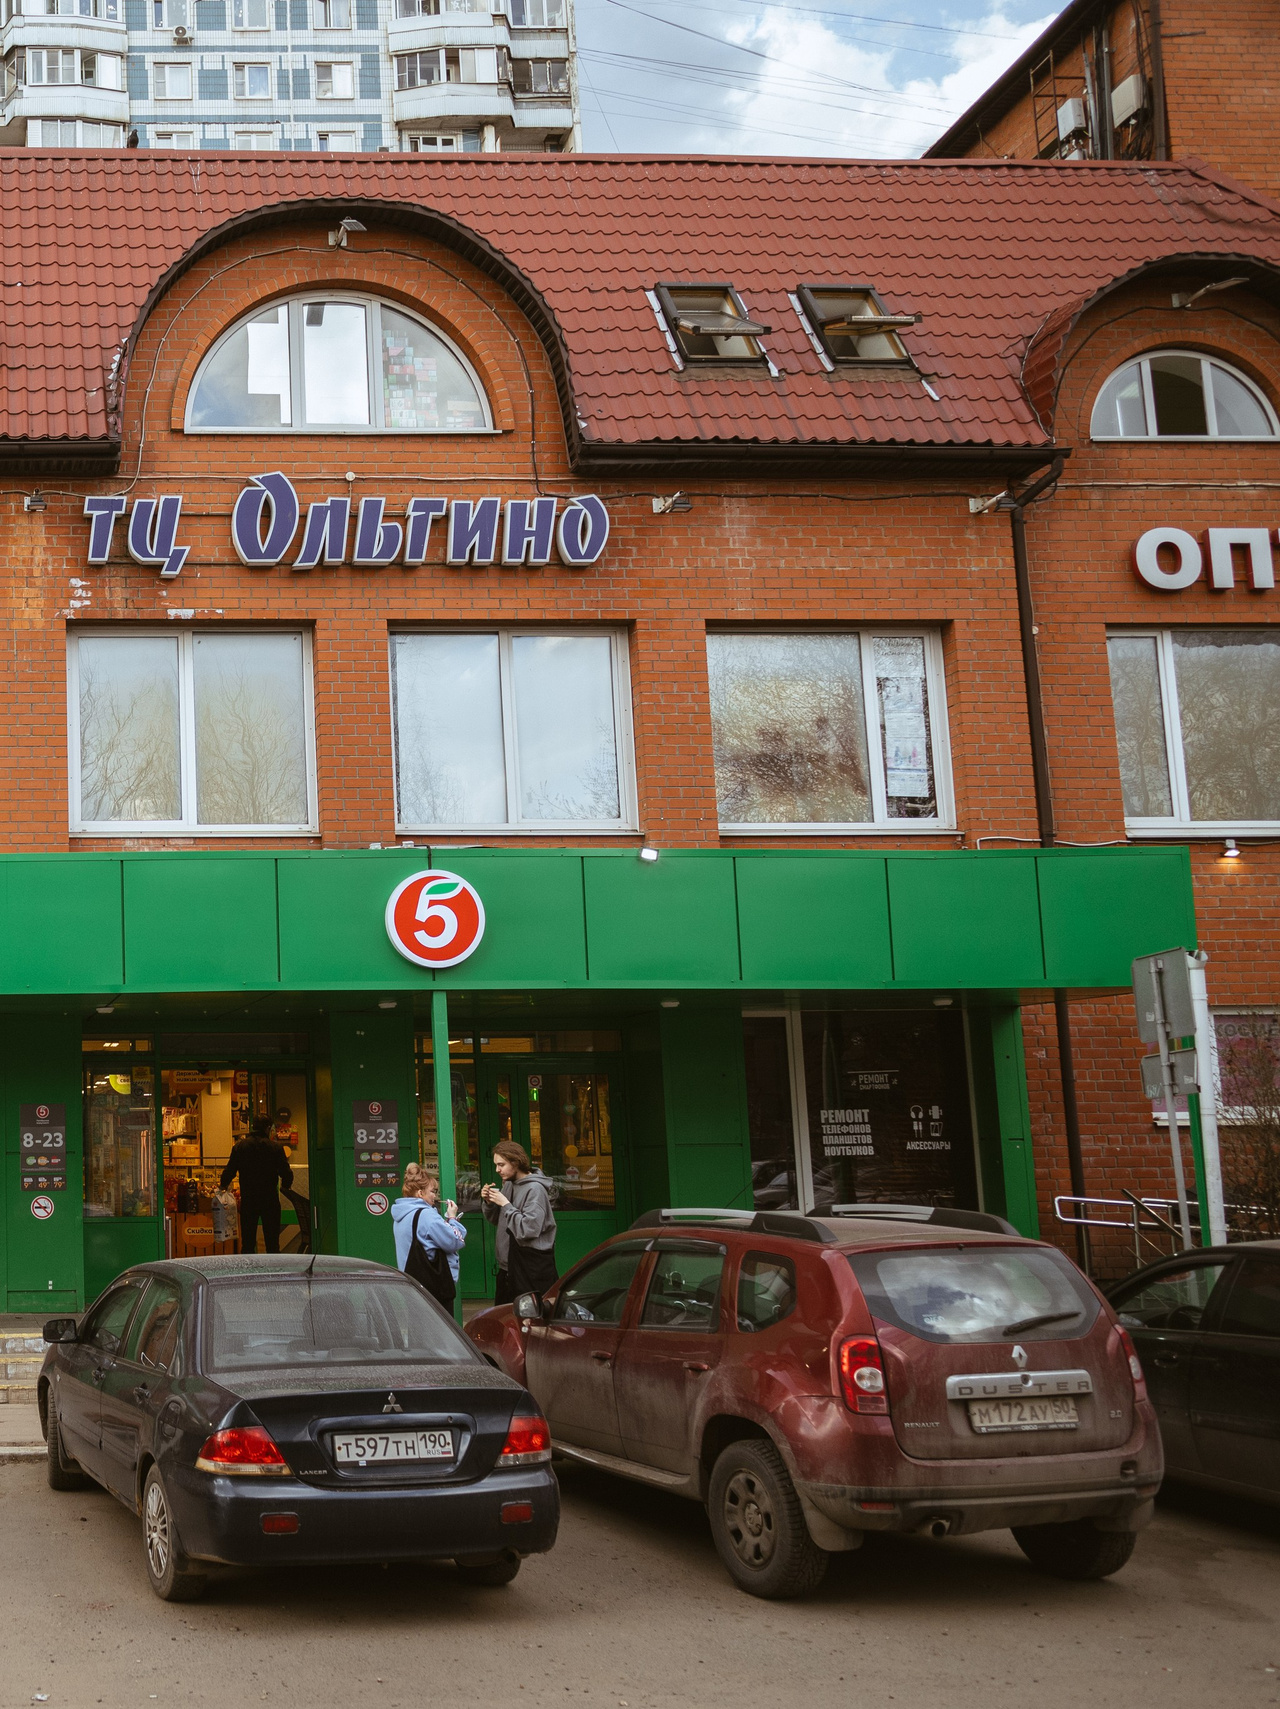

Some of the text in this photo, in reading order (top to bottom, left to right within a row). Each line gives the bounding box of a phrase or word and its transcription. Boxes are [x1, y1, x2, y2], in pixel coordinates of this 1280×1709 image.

[1131, 526, 1280, 591] ОП
[858, 1073, 889, 1084] РЕМОНТ
[820, 1109, 870, 1123] РЕМОНТ
[821, 1124, 872, 1134] ТЕЛЕФОНОВ
[823, 1135, 873, 1145] ПЛАНШЕТОВ
[906, 1141, 951, 1150] АКСЕССУАРЫ
[824, 1145, 875, 1156] НОУТБУКОВ
[958, 1381, 1090, 1396] DUSTER
[904, 1421, 940, 1429] RENAULT
[419, 1433, 447, 1449] 190
